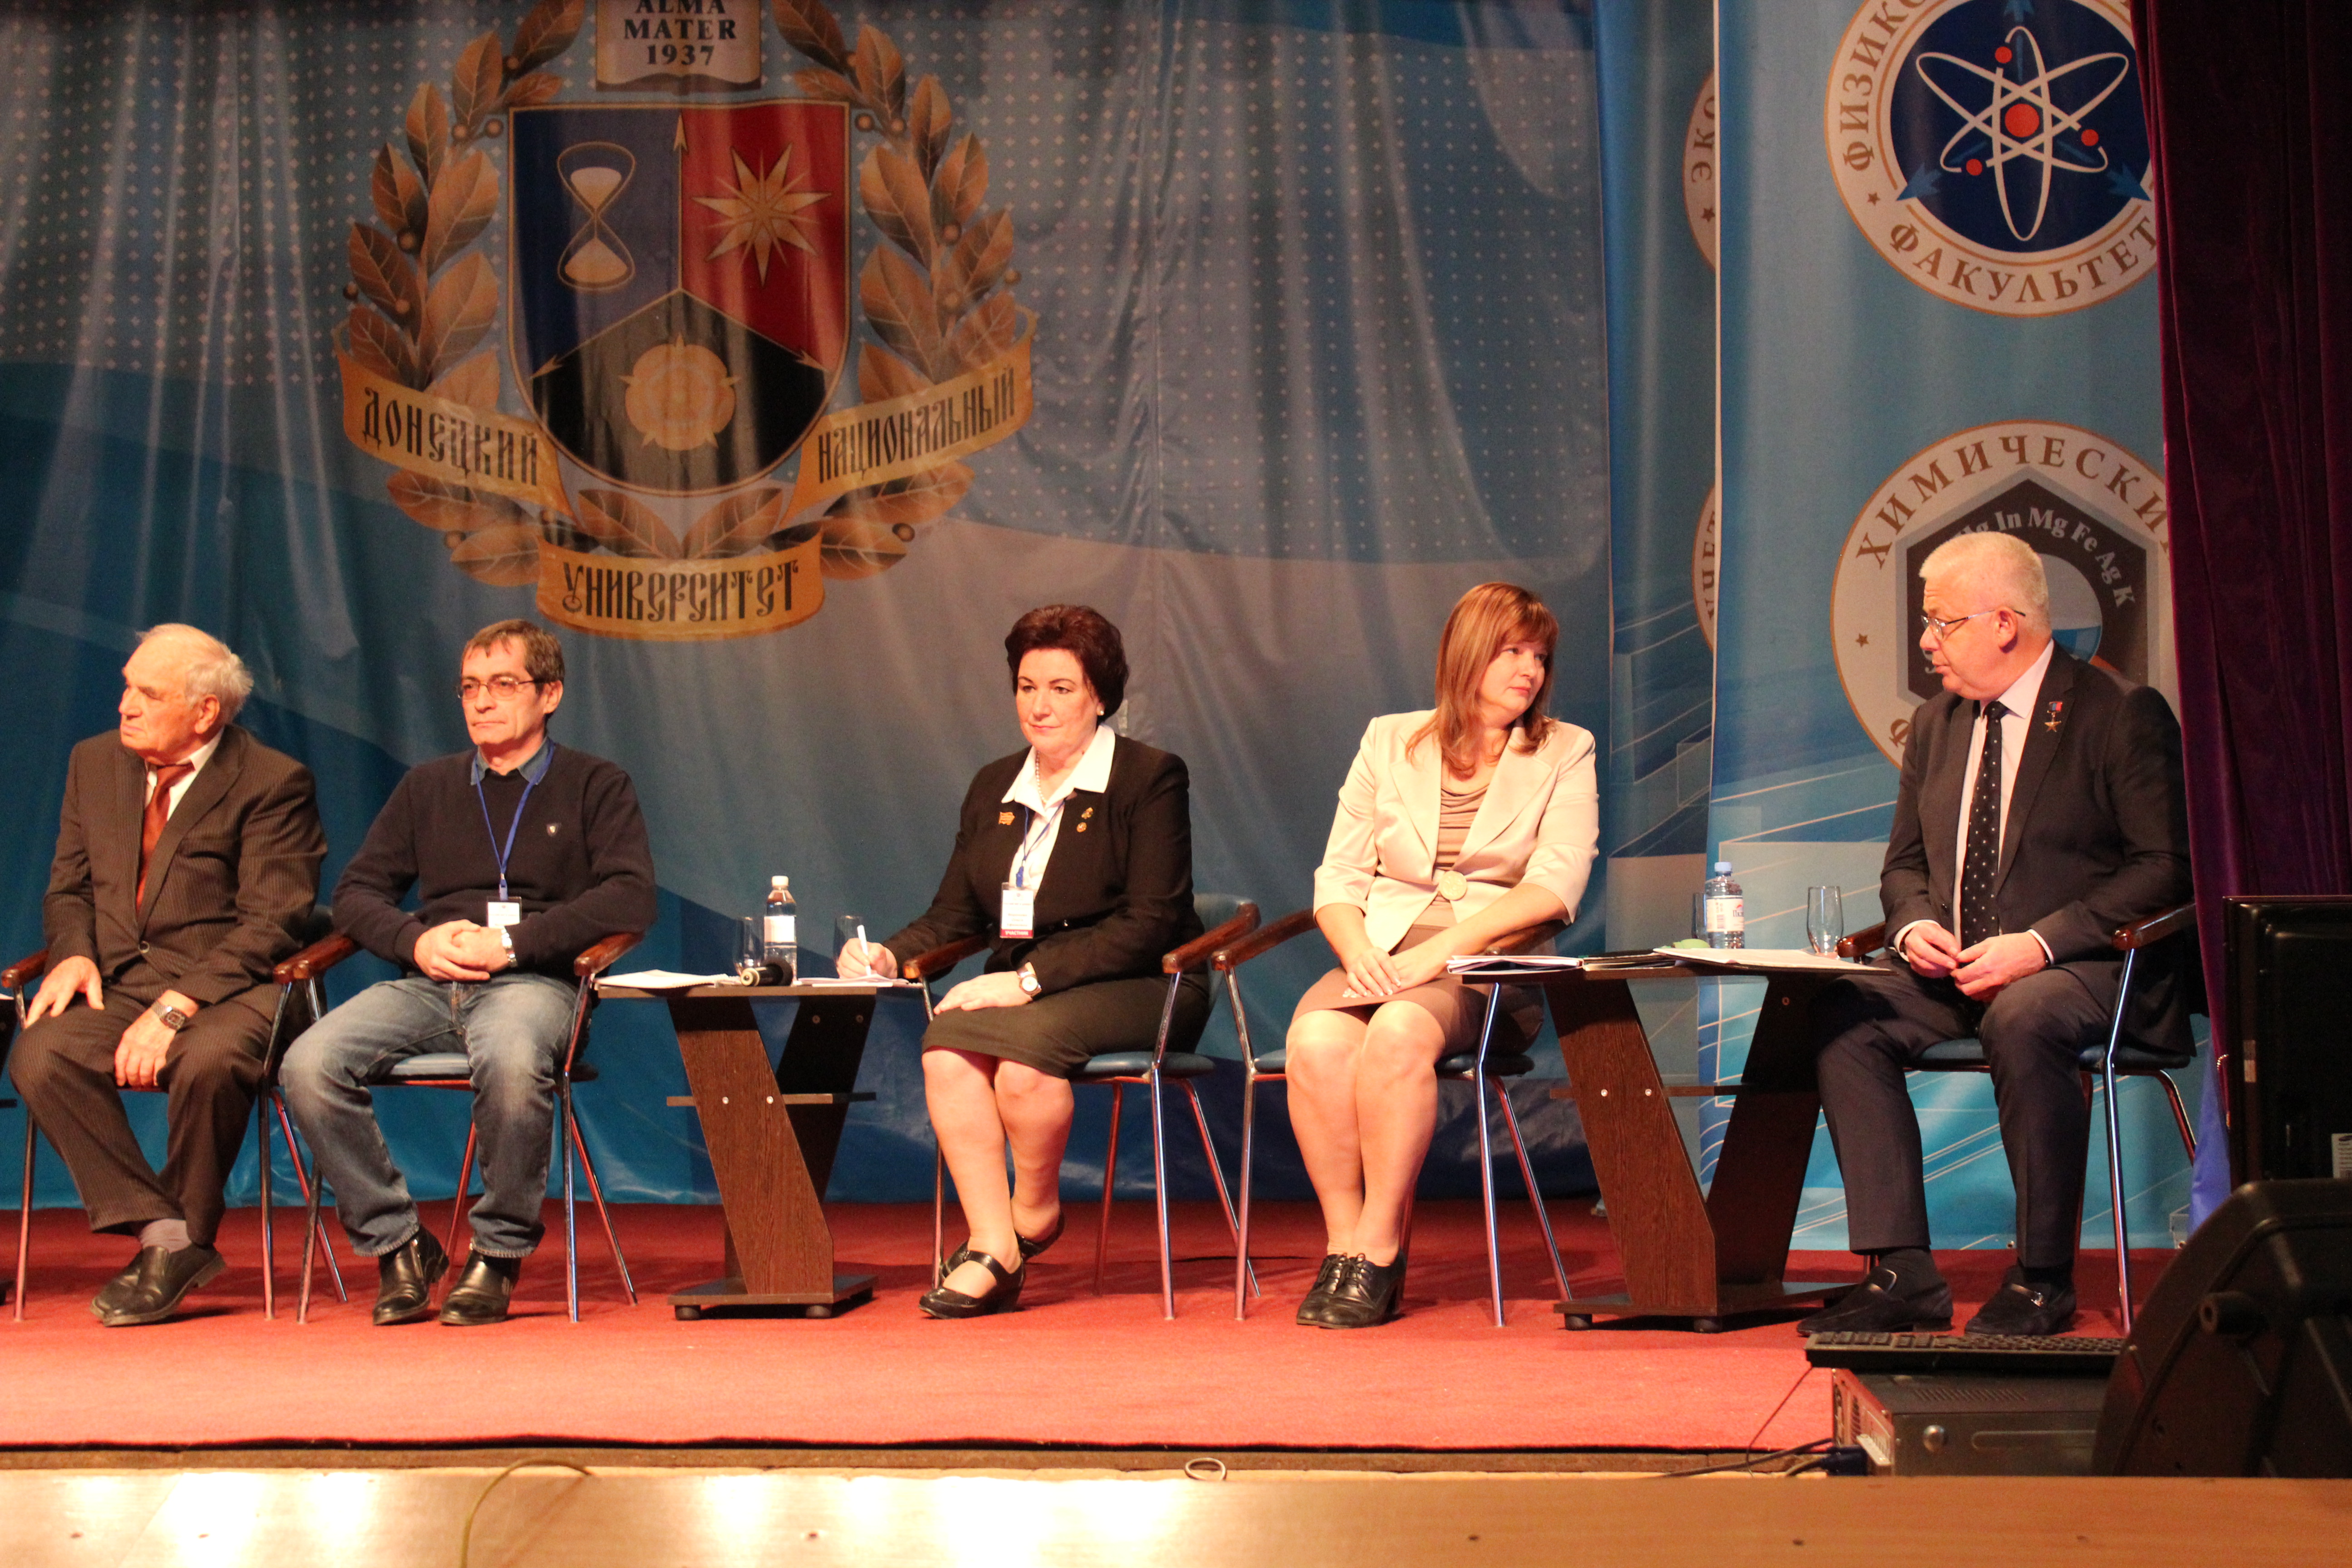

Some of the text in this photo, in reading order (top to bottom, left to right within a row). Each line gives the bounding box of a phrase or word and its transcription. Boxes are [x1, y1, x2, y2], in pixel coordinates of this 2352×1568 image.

[624, 19, 736, 40] MATER
[636, 0, 726, 14] ALMA
[647, 44, 715, 66] 1937
[1840, 0, 1926, 172] ФИЗИК
[1890, 216, 2156, 303] ФАКУЛЬТЕТ
[363, 387, 537, 486] ДОНЕЦКИЙ
[818, 366, 1014, 484] НАЦИОНАЛЬНЫЙ
[562, 559, 798, 622] УНИВЕРСИТЕТ
[1994, 510, 2022, 532] In
[2028, 507, 2068, 539] Mg
[2070, 524, 2098, 552] Fe
[2095, 551, 2122, 585] Ag
[2113, 585, 2135, 608] K
